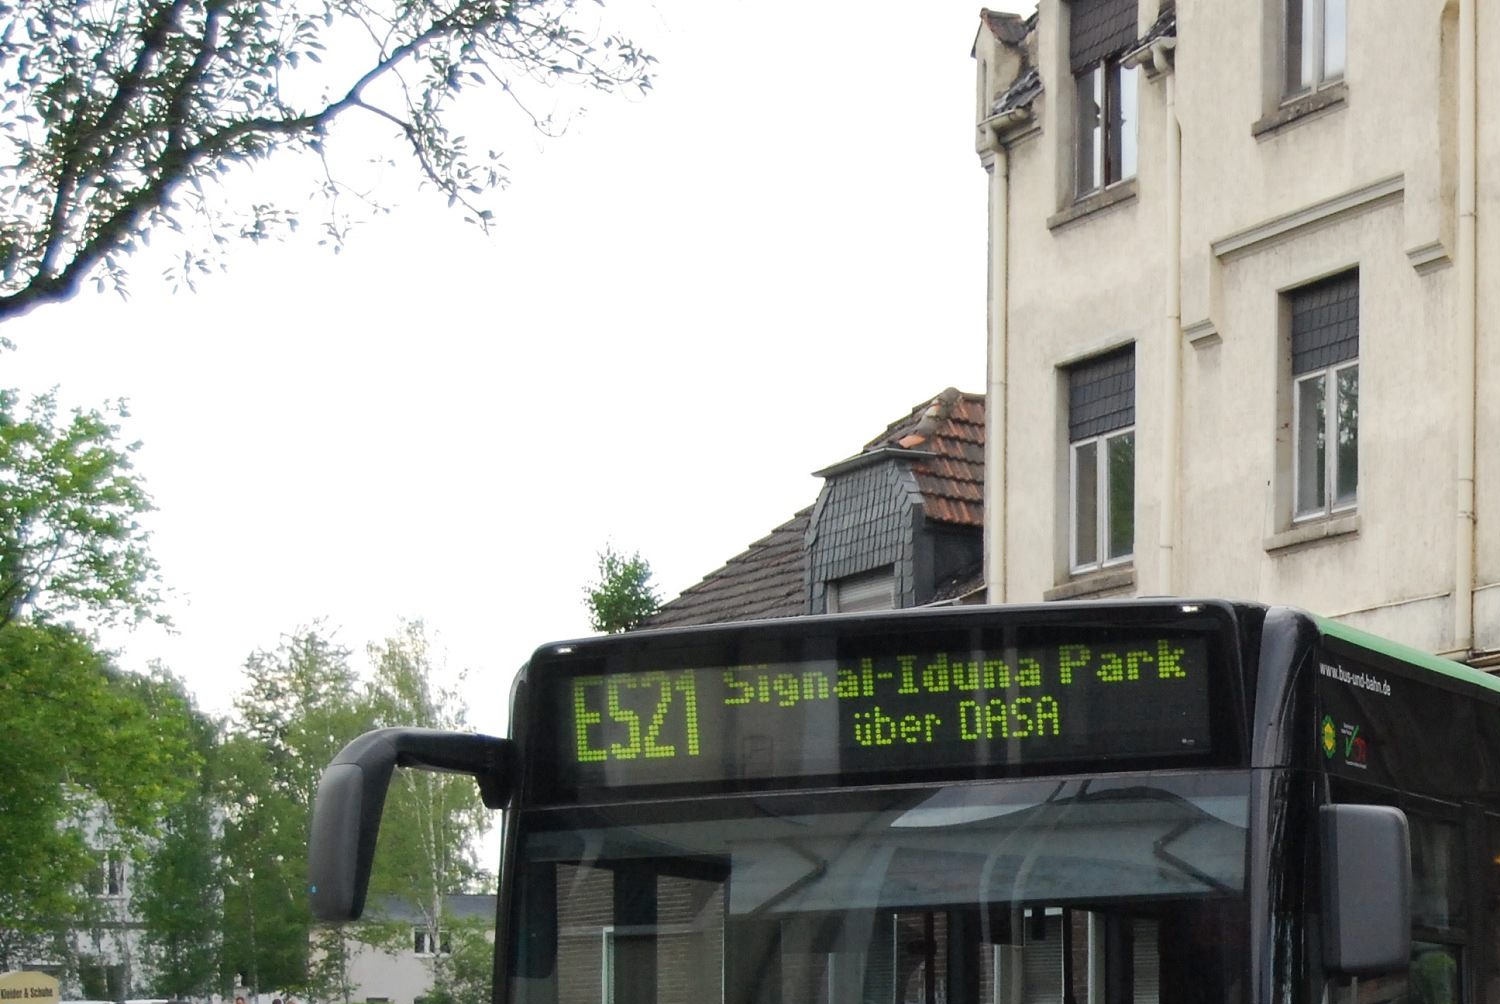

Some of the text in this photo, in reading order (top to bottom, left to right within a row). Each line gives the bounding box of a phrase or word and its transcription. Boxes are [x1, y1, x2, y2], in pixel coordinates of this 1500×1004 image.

[723, 639, 1187, 707] Signal-Iduna Park
[1319, 662, 1391, 696] www.bus-und-bahn.de
[854, 696, 1059, 746] über DASA
[30, 986, 53, 998] Schuhe
